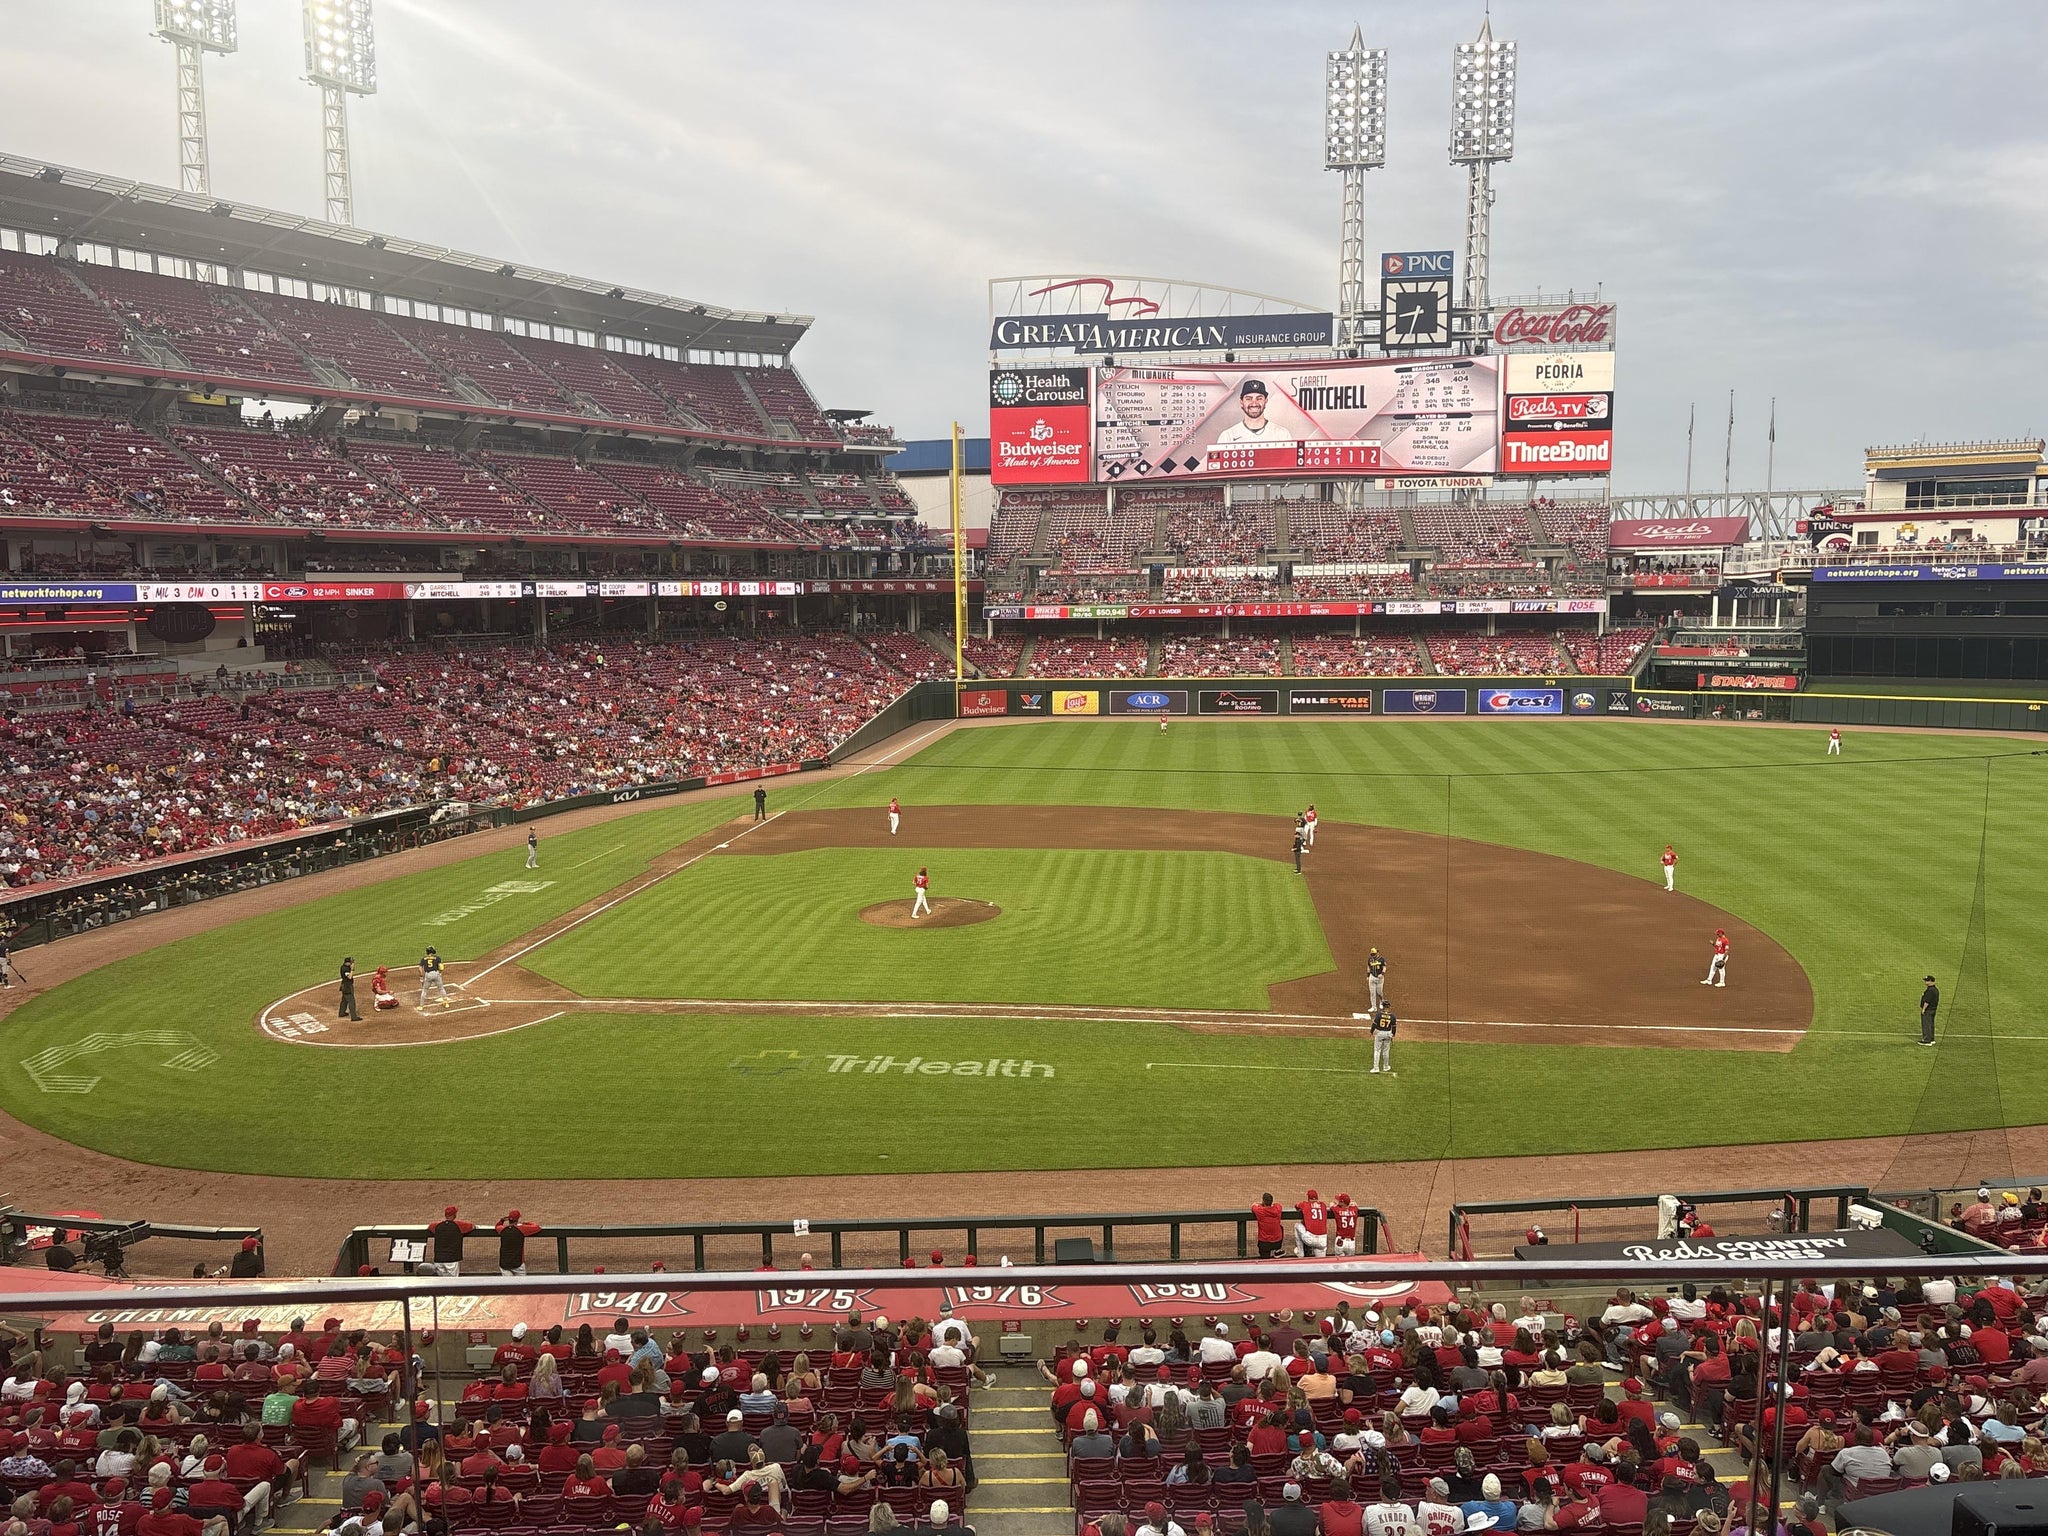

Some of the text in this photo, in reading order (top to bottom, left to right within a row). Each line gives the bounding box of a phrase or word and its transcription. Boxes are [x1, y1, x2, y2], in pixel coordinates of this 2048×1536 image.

[1407, 255, 1450, 272] PNC
[1494, 305, 1615, 345] Coca-Cola
[997, 320, 1326, 349] GREAT AMERICAN INSURANCE GROUP
[1132, 370, 1174, 379] MILWAUKEE
[1536, 364, 1583, 379] PEORIA
[1026, 375, 1070, 388] Health
[1300, 376, 1327, 387] GARRETT
[1026, 387, 1084, 401] Carousel
[1299, 385, 1367, 410] MITCHELL
[1513, 396, 1582, 418] Reds.TV
[999, 442, 1082, 456] Budweiser
[1507, 440, 1608, 462] ThreeBond
[998, 456, 1080, 468] Made of America
[1026, 492, 1070, 501] TARPS
[1141, 490, 1186, 500] TARPS
[1633, 523, 1712, 539] Reds
[1827, 569, 1919, 577] networkforhope.org
[2, 588, 102, 599] networkforhope.org
[174, 588, 180, 597] 3
[188, 587, 204, 598] CIN
[212, 588, 218, 597] 0
[1568, 601, 1595, 612] ROSE
[1711, 676, 1786, 688] STAR FIRE
[1067, 696, 1085, 709] Lay's
[1135, 696, 1160, 704] ACR
[1490, 693, 1554, 708] Crest
[963, 706, 1005, 714] Budweiser
[614, 790, 640, 802] KIA
[1380, 1019, 1390, 1028] 67
[826, 1054, 1056, 1078] TriHealth
[1311, 1208, 1323, 1220] 31
[1341, 1217, 1354, 1228] 54
[1623, 1238, 1847, 1261] Reds COUNTRY CARES
[956, 1283, 1043, 1306] 1976
[1141, 1281, 1229, 1300] 1990
[577, 1291, 669, 1314] 1940
[768, 1288, 858, 1308] 1975
[1246, 1416, 1254, 1426] 4
[572, 1486, 591, 1495] LARKIN
[96, 1510, 123, 1522] ROSE
[1378, 1513, 1408, 1524] KINDER
[1428, 1512, 1456, 1524] GRIFFEY
[97, 1524, 119, 1536] 14
